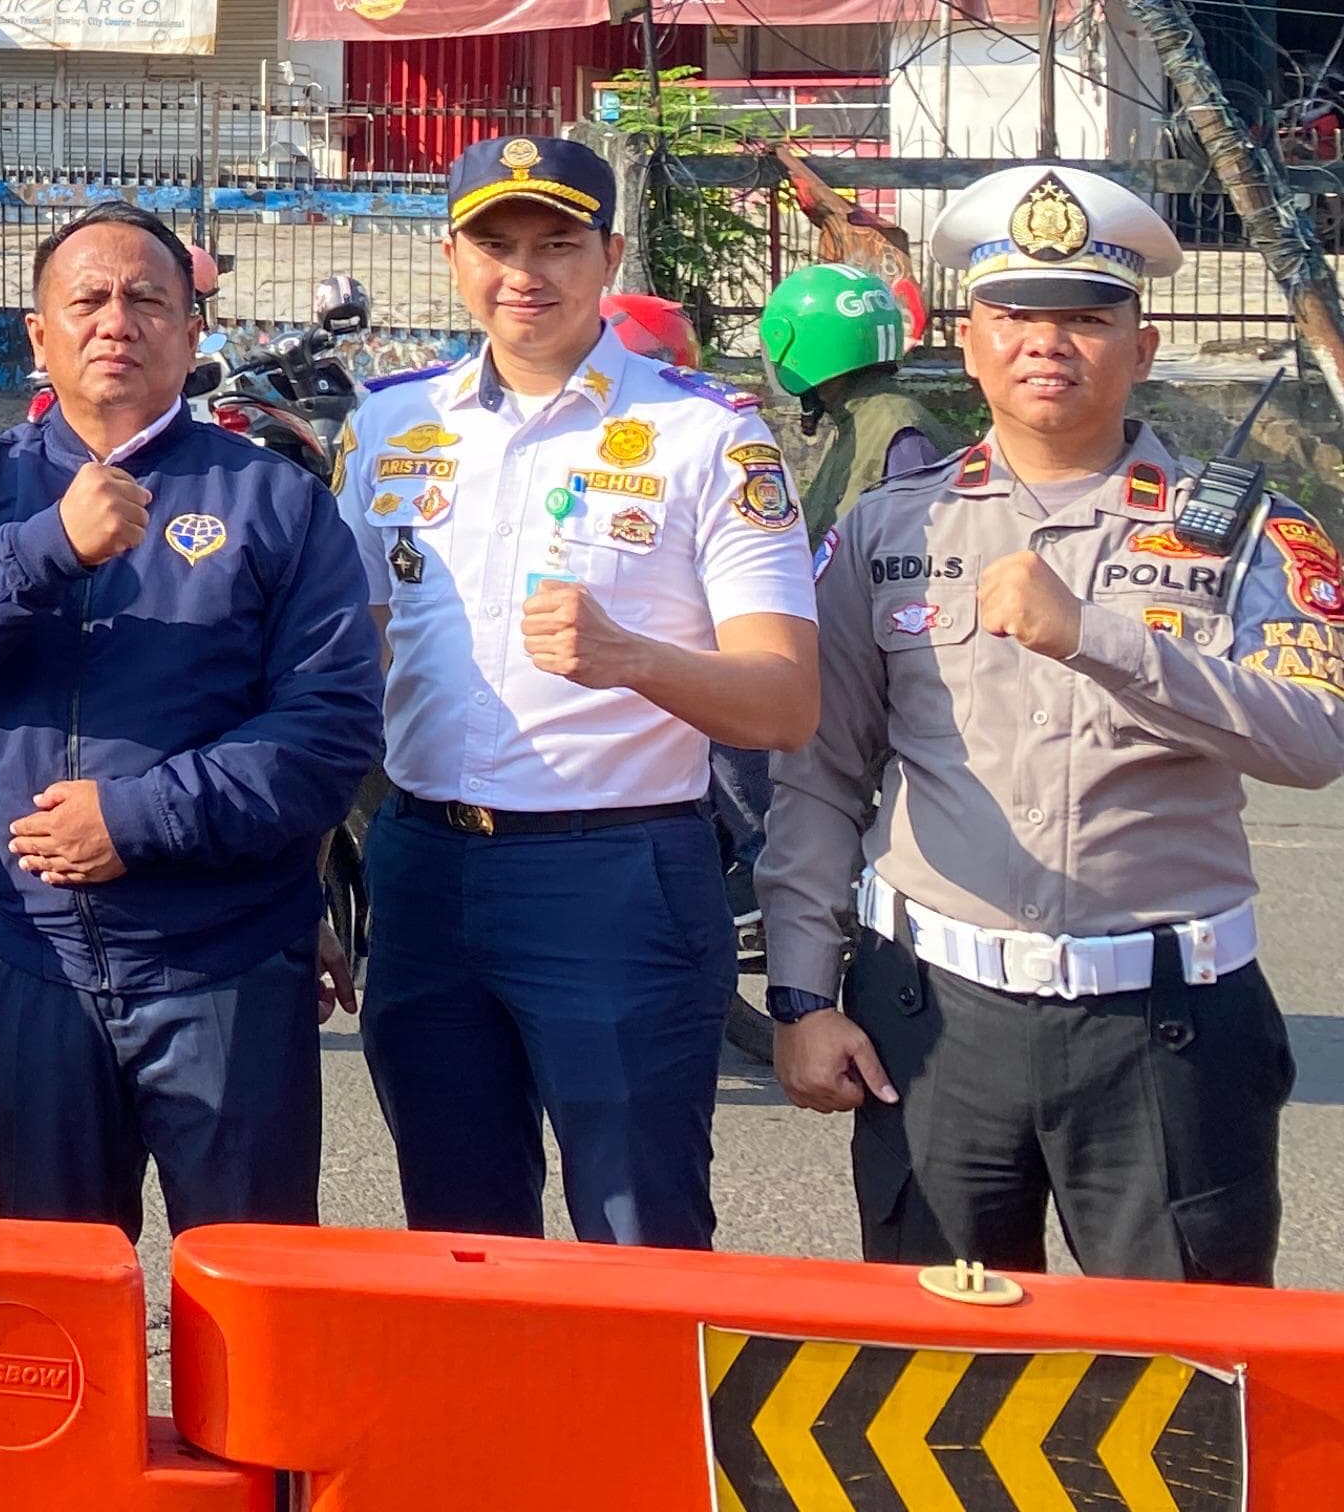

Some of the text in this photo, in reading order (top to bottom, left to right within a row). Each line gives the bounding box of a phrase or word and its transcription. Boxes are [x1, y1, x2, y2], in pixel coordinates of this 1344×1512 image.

[55, 0, 161, 16] CARGO
[381, 460, 450, 474] ARISTYO
[871, 555, 963, 584] DEDI.S
[1102, 564, 1227, 597] POLRI
